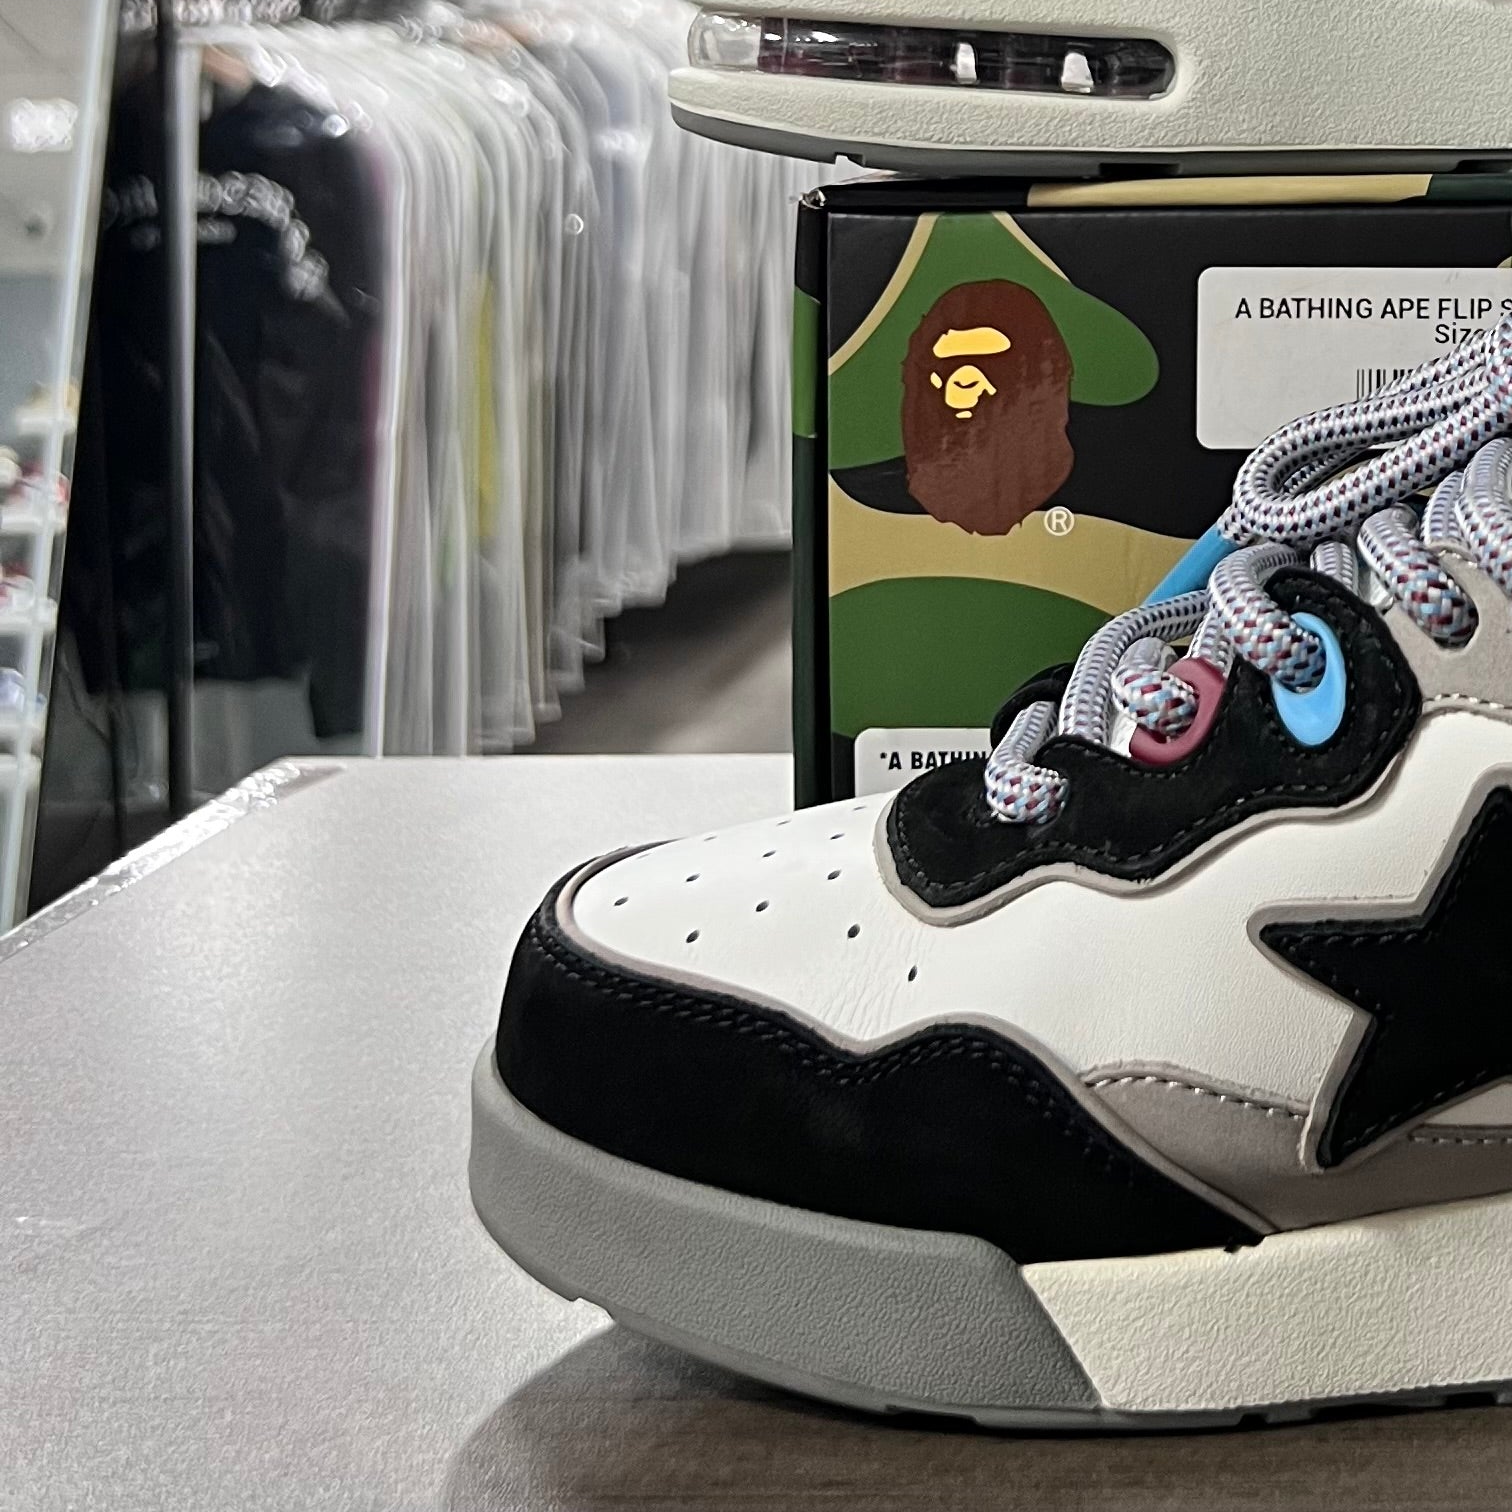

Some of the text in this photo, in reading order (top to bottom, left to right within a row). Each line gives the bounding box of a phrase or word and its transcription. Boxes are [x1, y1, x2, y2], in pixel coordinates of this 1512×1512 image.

[1235, 297, 1252, 320] A
[1260, 297, 1373, 320] BATHING
[1380, 297, 1430, 320] APE
[1438, 297, 1492, 320] FLIP
[1434, 321, 1486, 345] Siz
